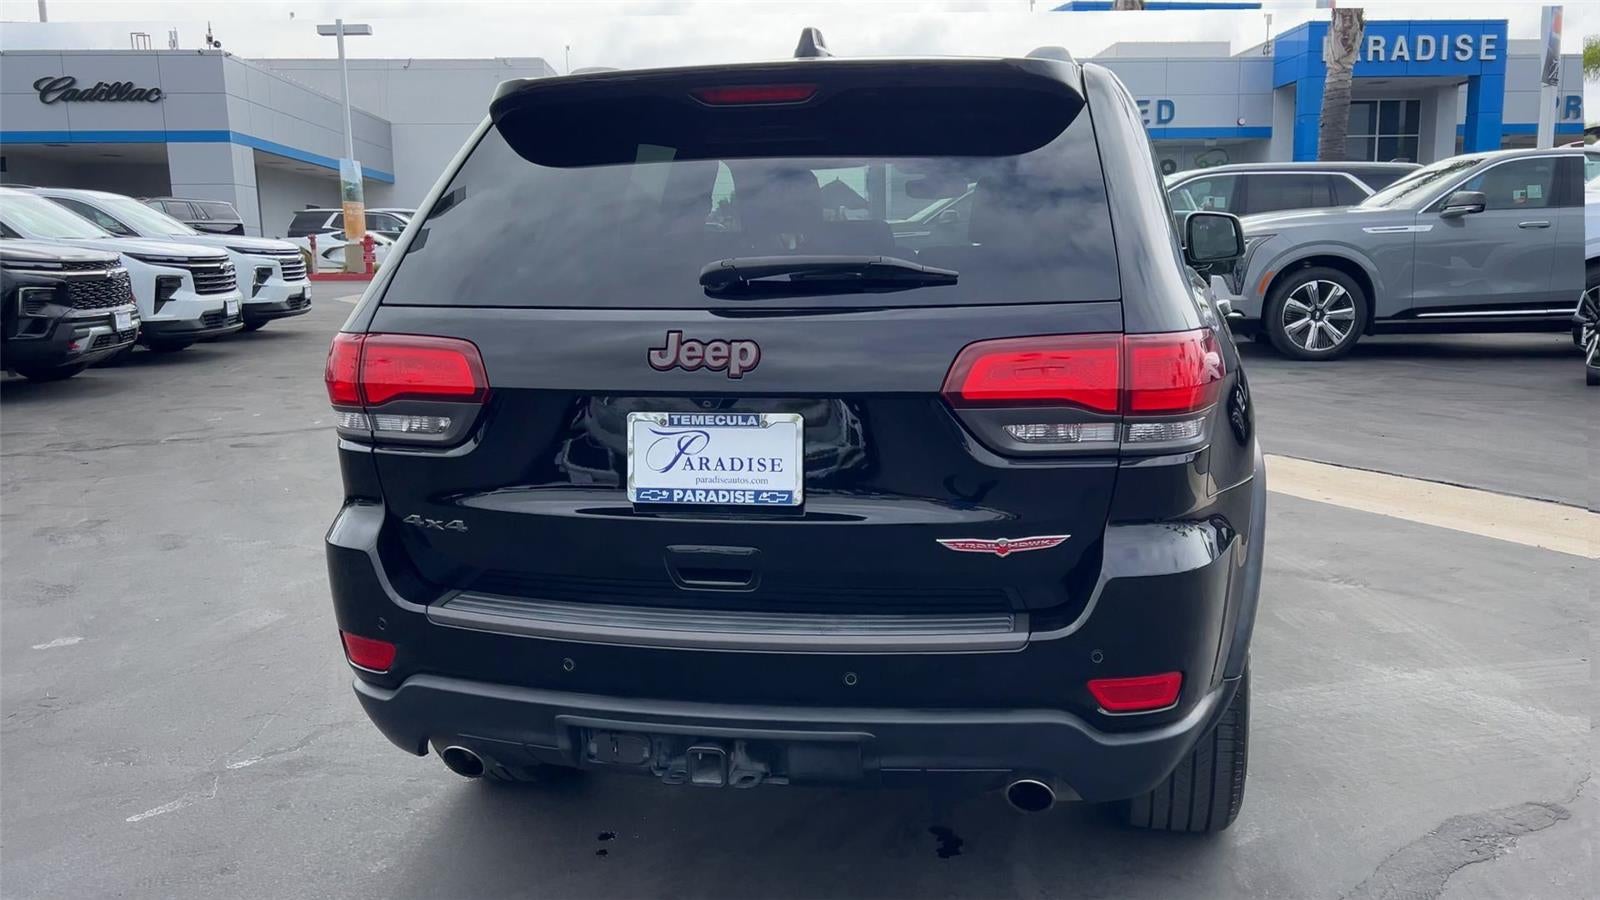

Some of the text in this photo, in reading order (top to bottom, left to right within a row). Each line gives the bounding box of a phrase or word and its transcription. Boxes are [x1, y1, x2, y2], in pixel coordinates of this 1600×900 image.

[1322, 34, 1498, 62] RADISE
[33, 76, 162, 104] Cadillac
[648, 330, 761, 379] Jeep
[671, 414, 757, 426] TEMECULA
[646, 427, 783, 473] PARADISE
[695, 475, 769, 485] paradiseautos.com
[673, 489, 755, 503] PARADISE
